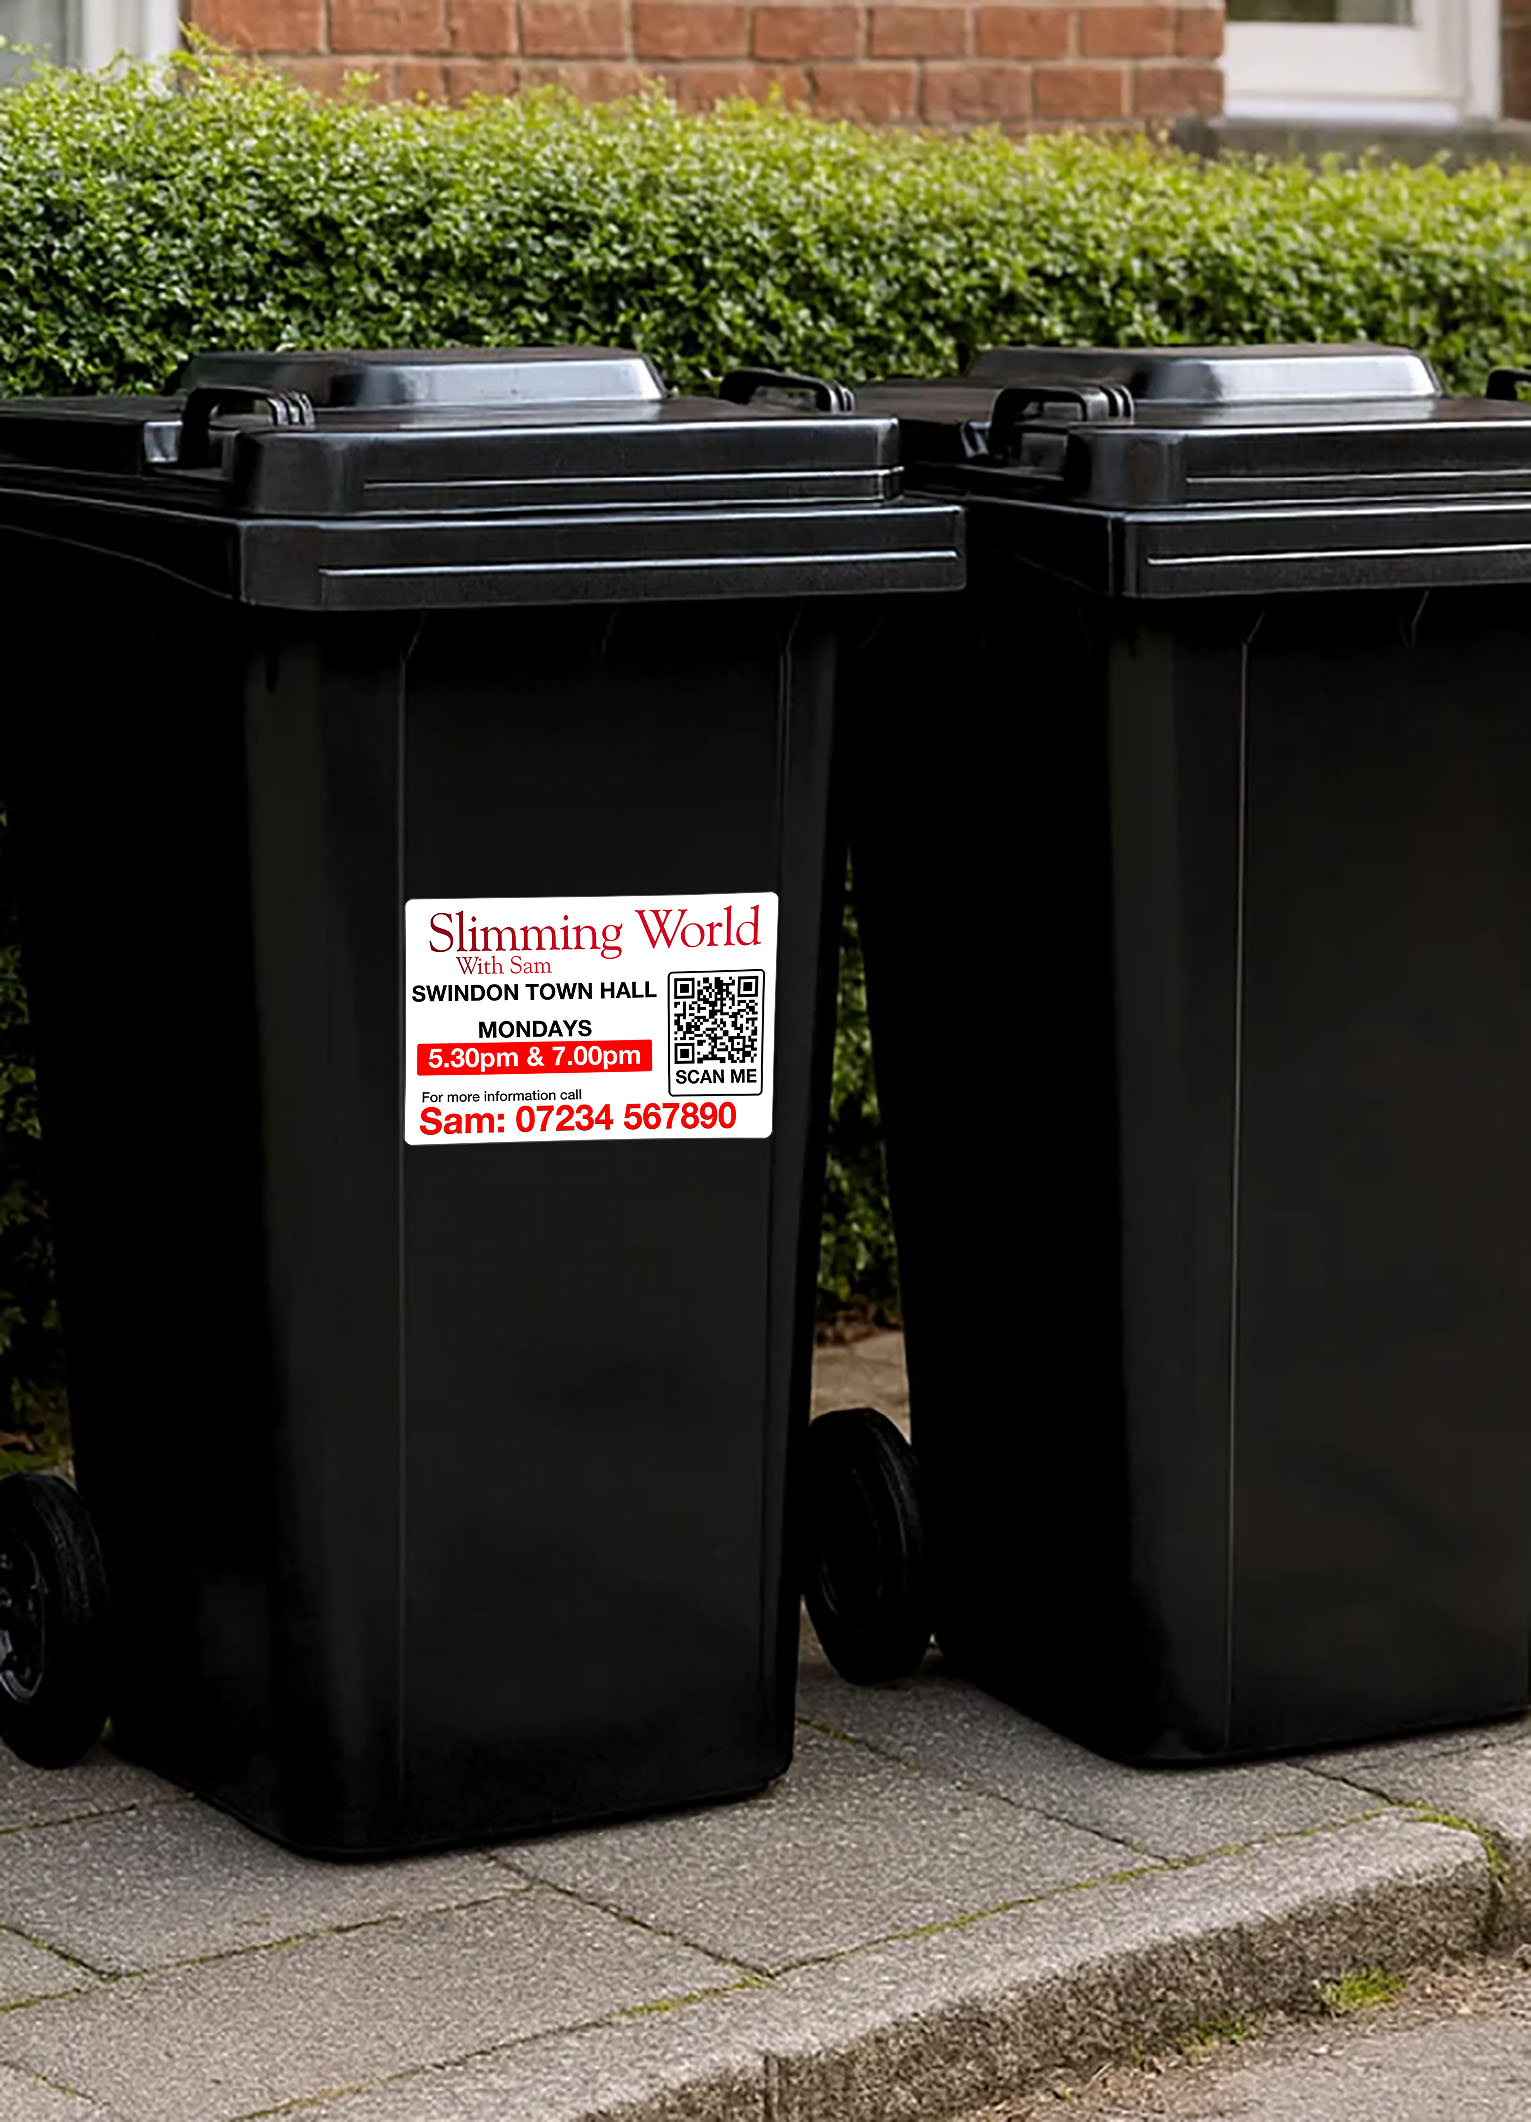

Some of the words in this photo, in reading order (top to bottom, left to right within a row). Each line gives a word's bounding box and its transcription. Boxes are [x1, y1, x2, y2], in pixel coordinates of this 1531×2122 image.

[429, 911, 622, 959] Slimming
[635, 905, 761, 949] World
[456, 956, 504, 974] With
[511, 956, 552, 974] Sam
[412, 984, 518, 1002] SWINDON
[525, 983, 592, 1000] TOWN
[601, 981, 657, 999] HALL
[479, 1020, 592, 1038] MONDAYS
[429, 1048, 518, 1071] 5.30pm
[527, 1047, 544, 1066] &
[552, 1046, 640, 1069] 7.00pm
[676, 1069, 724, 1084] SCAN
[731, 1069, 757, 1083] ME
[422, 1092, 443, 1103] For
[448, 1094, 480, 1102] more
[484, 1090, 556, 1101] information
[560, 1089, 581, 1100] call
[420, 1107, 504, 1135] Sam:
[516, 1104, 613, 1132] 07234
[624, 1102, 736, 1130] 567890
